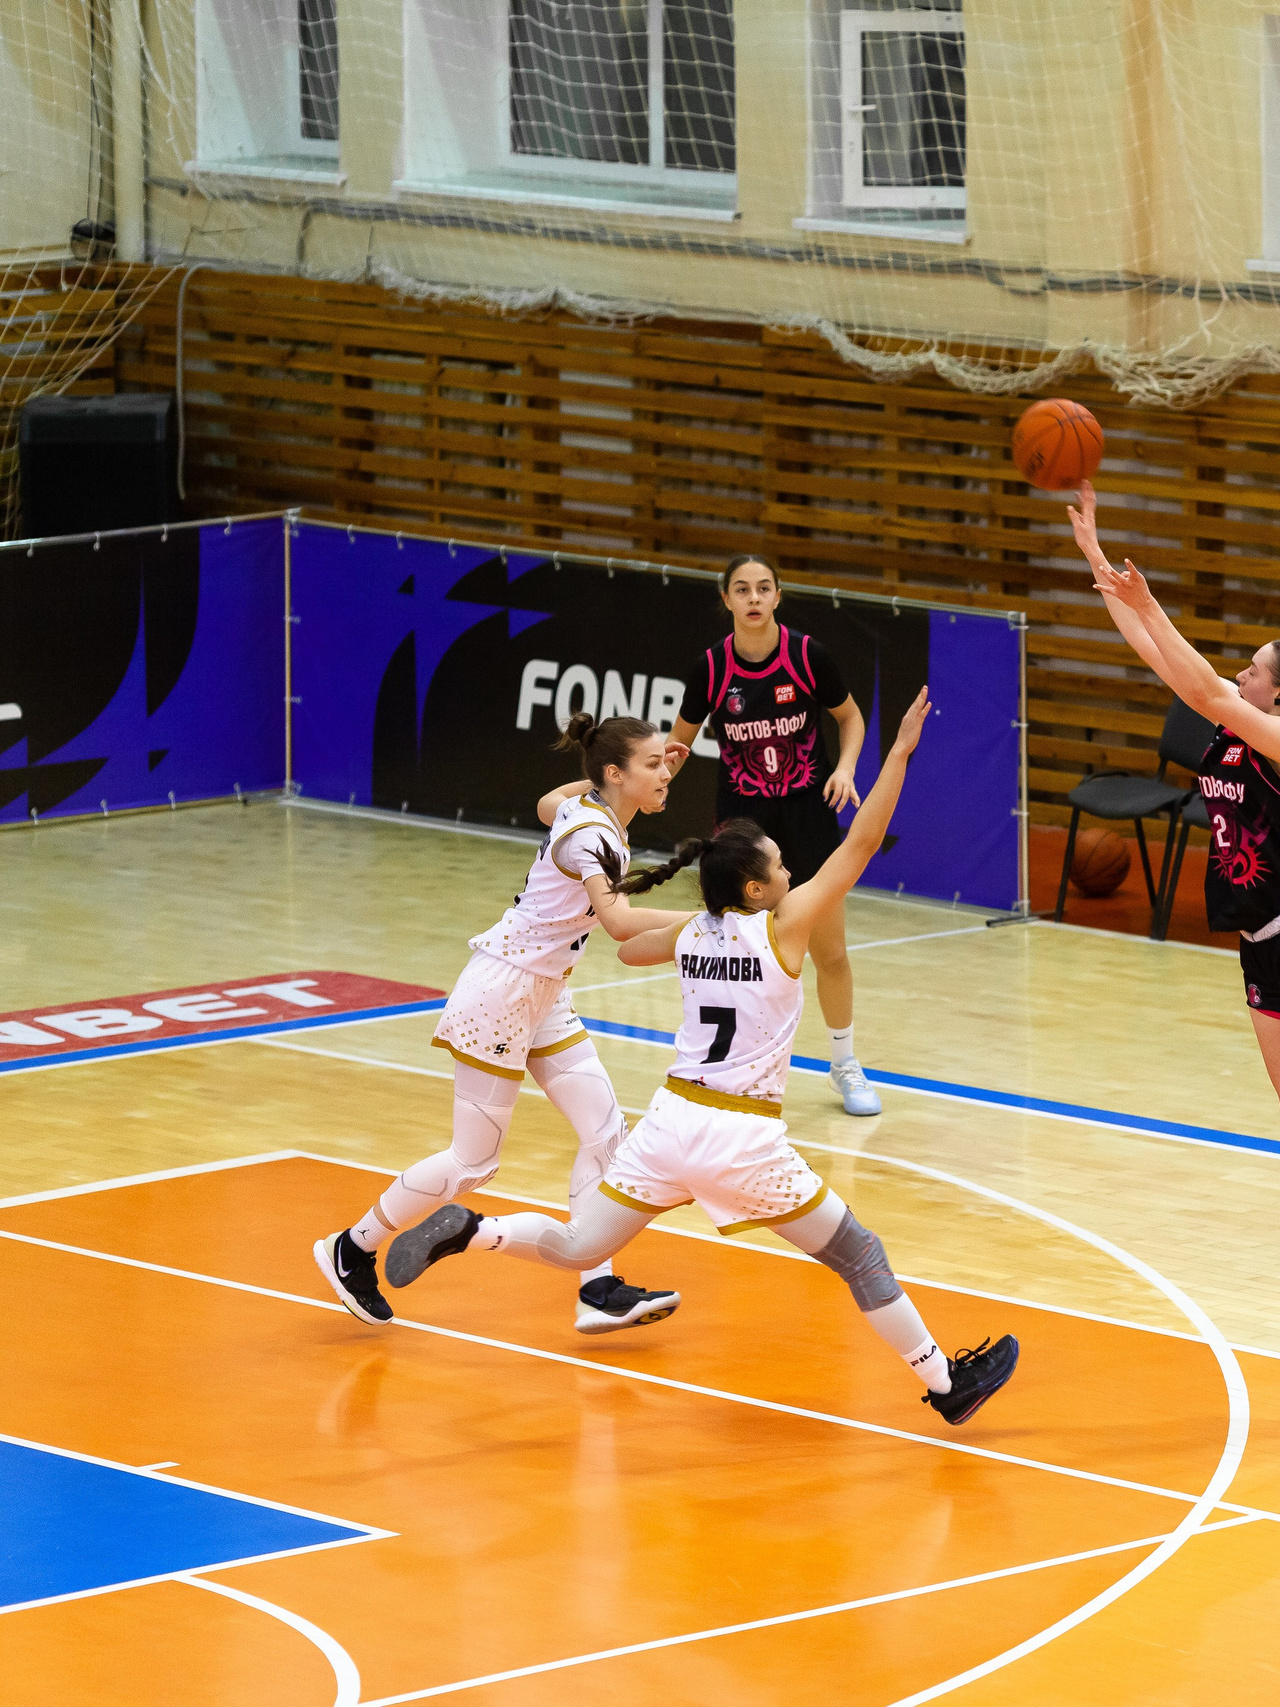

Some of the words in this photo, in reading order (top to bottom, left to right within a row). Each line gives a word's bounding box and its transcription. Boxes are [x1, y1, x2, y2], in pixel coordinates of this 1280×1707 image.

[775, 686, 793, 695] FON
[776, 693, 794, 702] BET
[724, 711, 807, 742] РОСТОВ-ЮФУ
[763, 746, 779, 774] 9
[1223, 754, 1240, 763] BET
[1227, 747, 1243, 755] FON
[1213, 814, 1231, 847] 2
[681, 953, 763, 982] РАХИМОВА
[699, 1006, 737, 1065] 7
